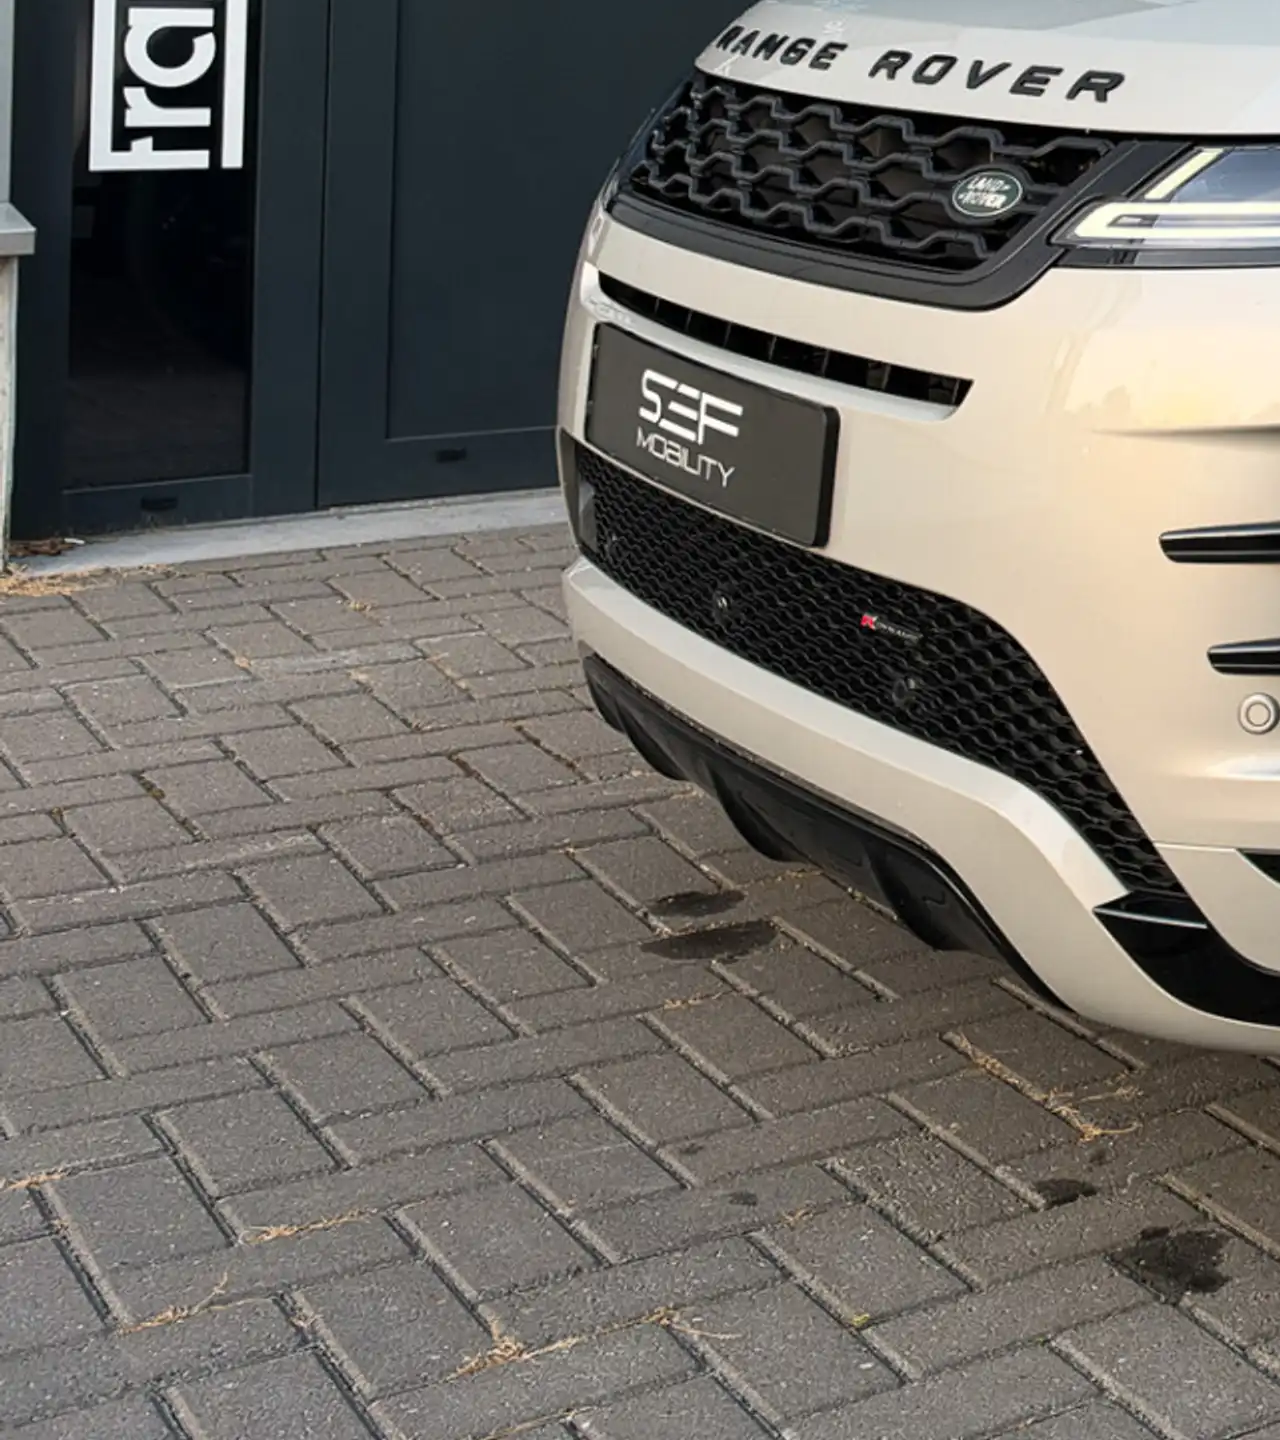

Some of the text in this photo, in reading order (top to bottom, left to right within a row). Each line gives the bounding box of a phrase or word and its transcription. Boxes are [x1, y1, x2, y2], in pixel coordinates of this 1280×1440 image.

[715, 25, 1126, 103] RANGE ROVER
[638, 368, 743, 445] SEF
[636, 426, 735, 488] MOBILITY
